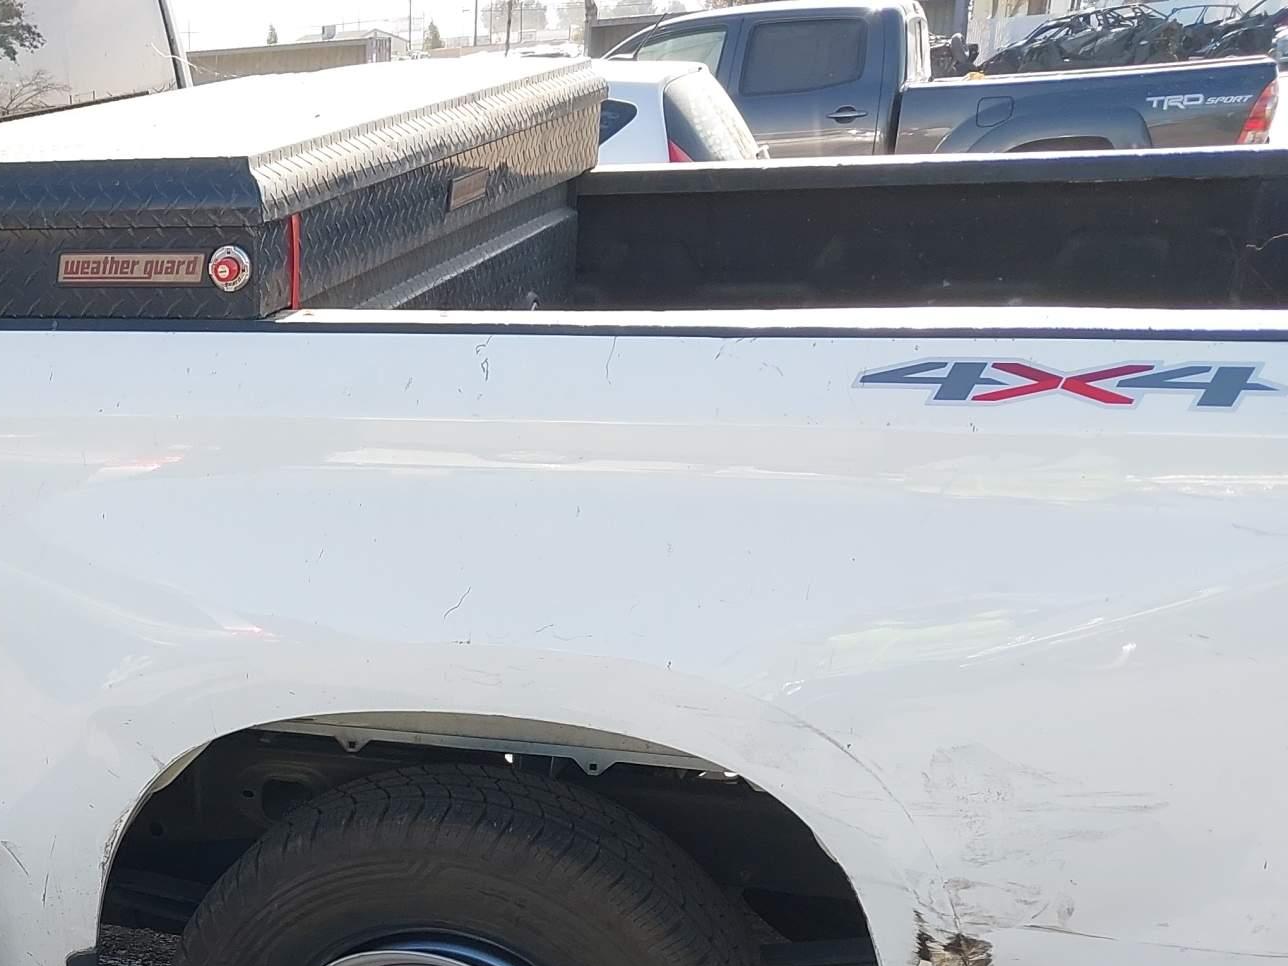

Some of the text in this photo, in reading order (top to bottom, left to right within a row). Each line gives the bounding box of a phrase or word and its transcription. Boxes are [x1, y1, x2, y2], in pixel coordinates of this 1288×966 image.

[1146, 94, 1253, 110] TRD SPORT
[63, 256, 199, 280] weather guard
